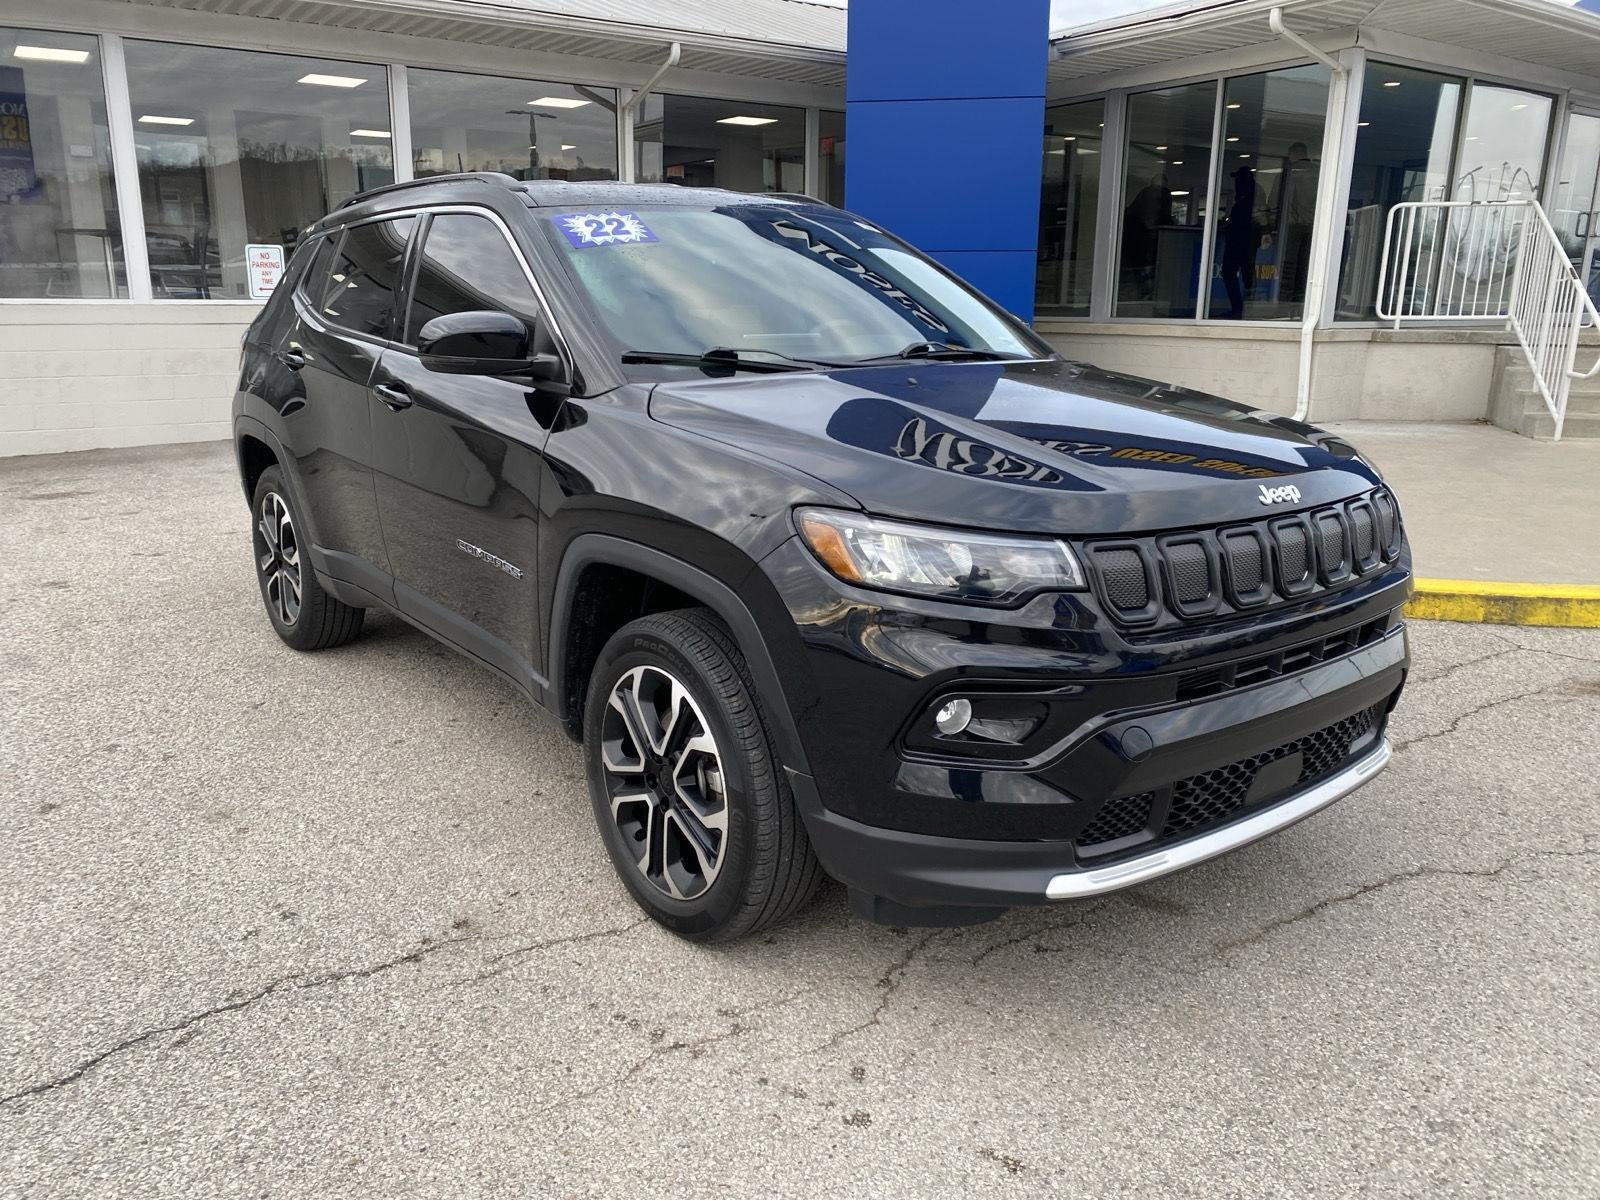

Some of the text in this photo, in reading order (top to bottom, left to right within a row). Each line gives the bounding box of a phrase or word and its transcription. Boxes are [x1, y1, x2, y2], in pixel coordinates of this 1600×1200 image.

[585, 217, 632, 237] 22
[252, 261, 280, 269] PARKING
[1258, 484, 1302, 506] Jeep
[455, 538, 524, 580] COMPASS
